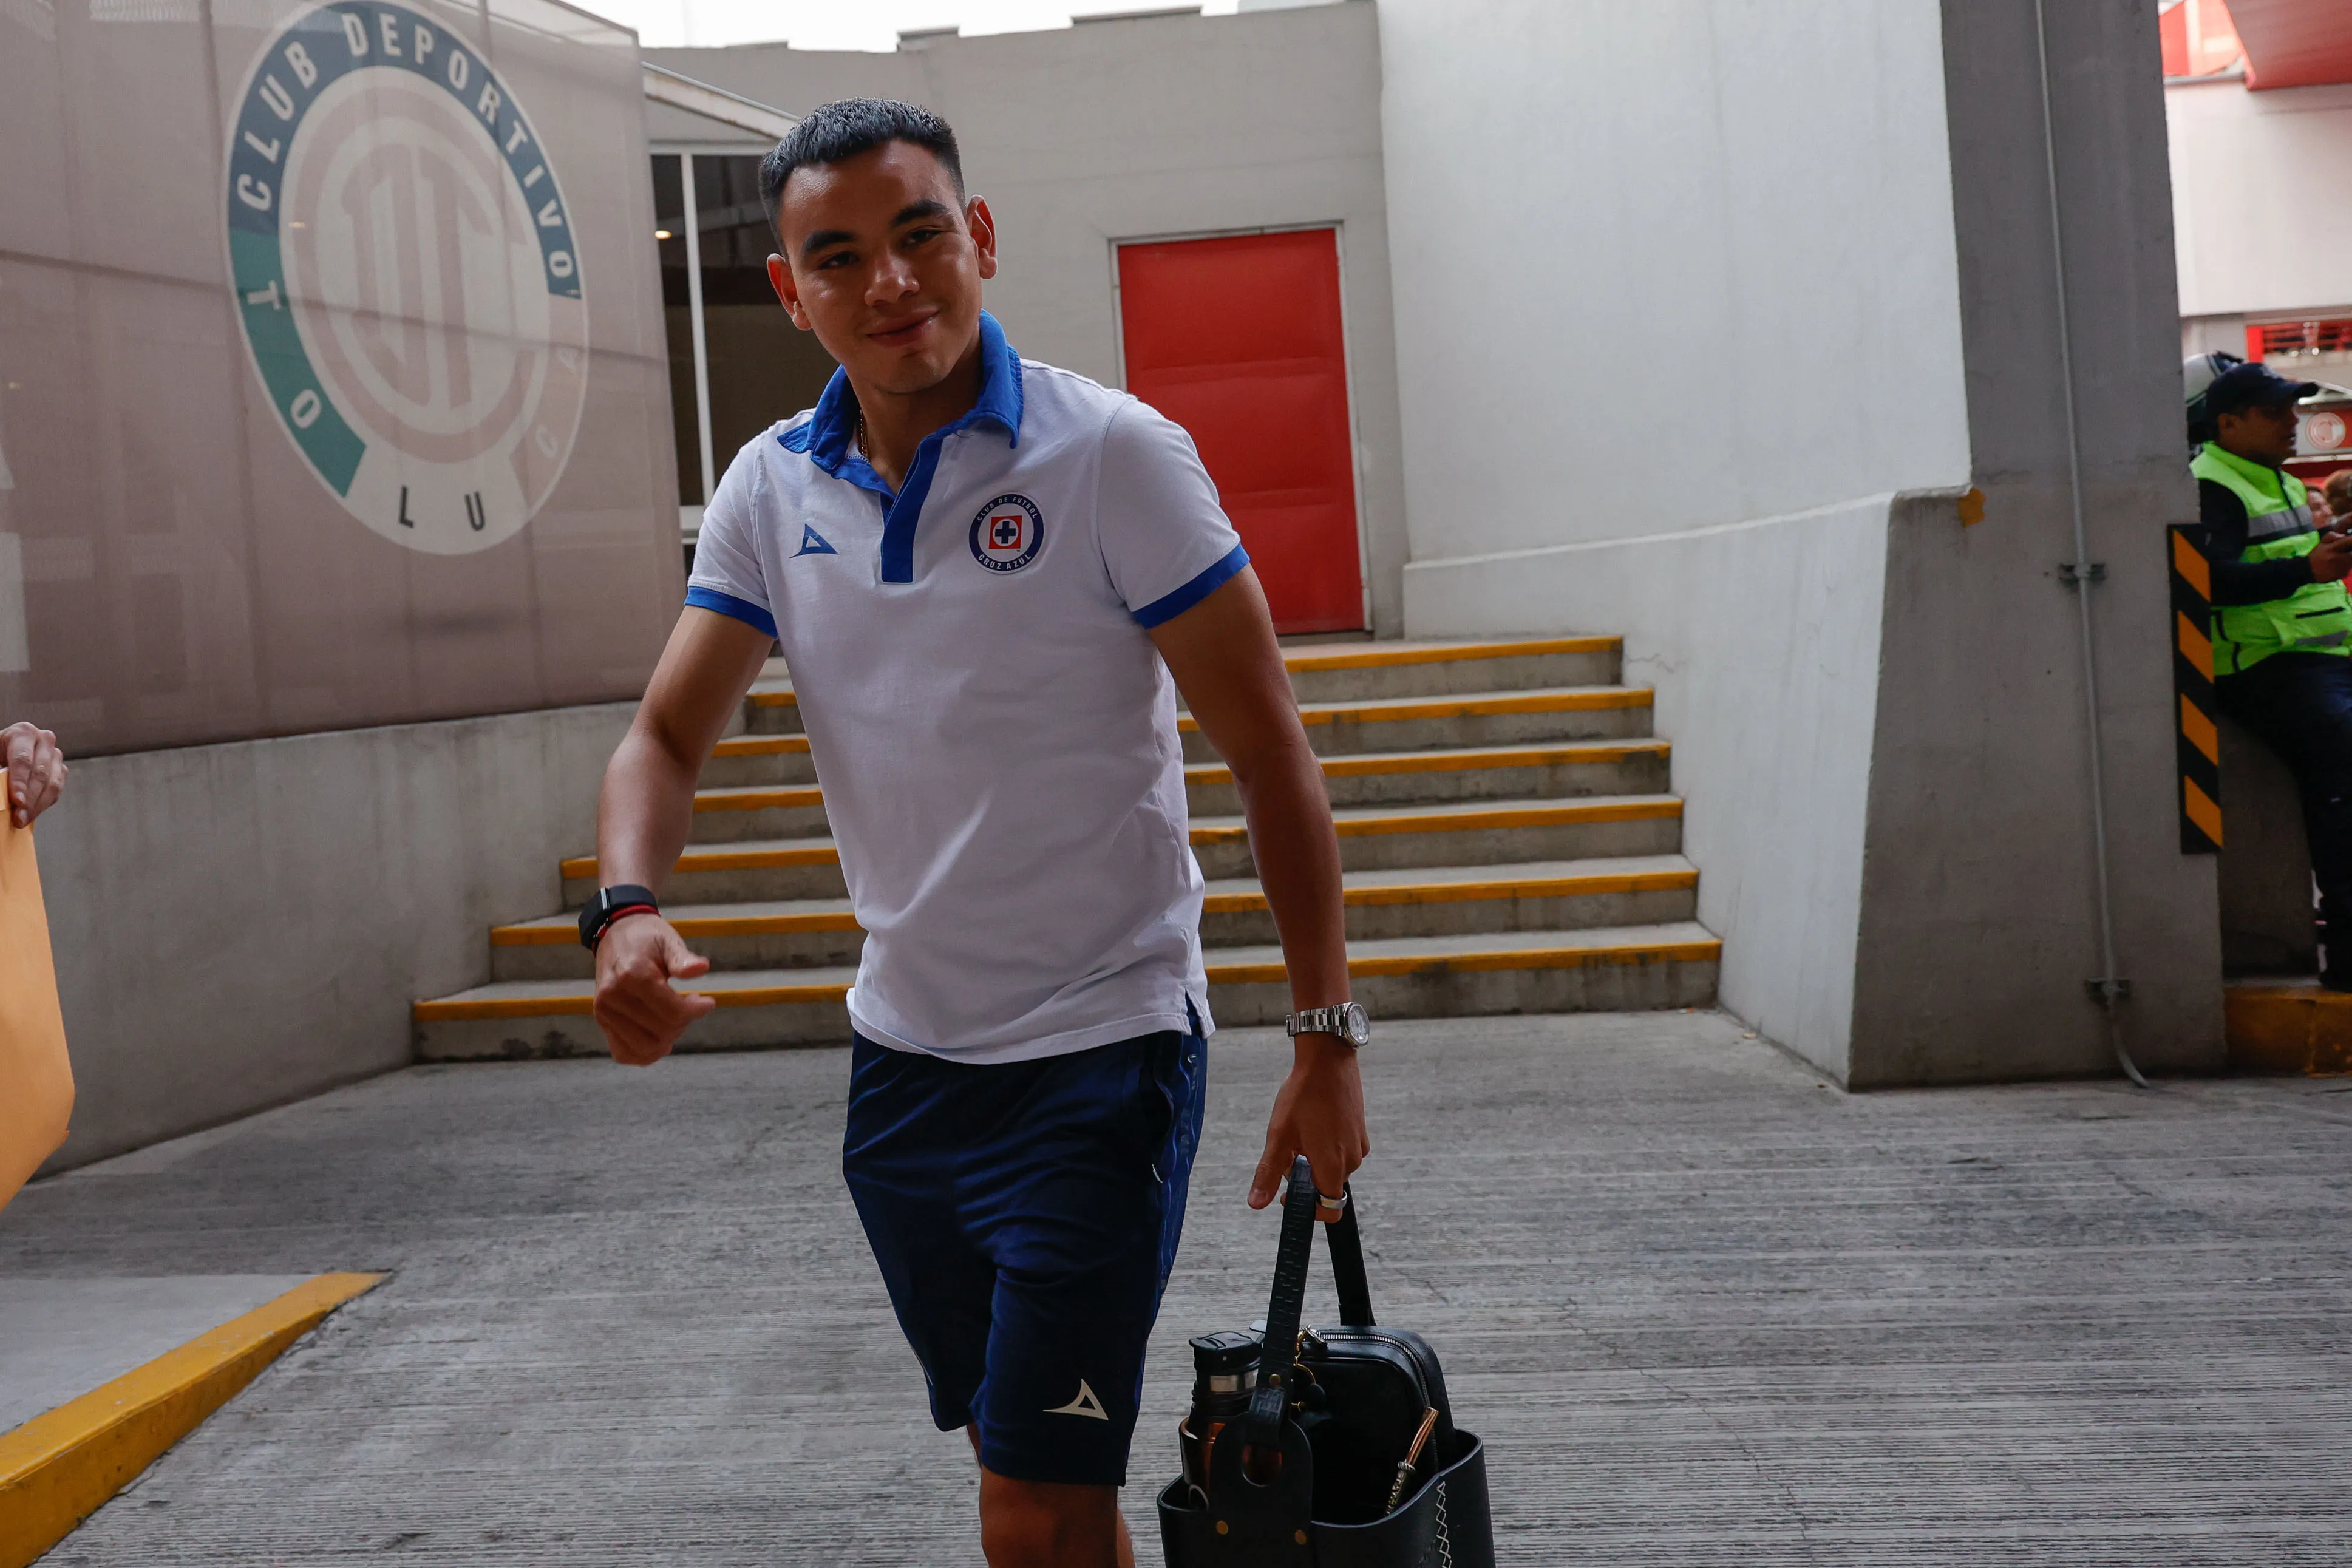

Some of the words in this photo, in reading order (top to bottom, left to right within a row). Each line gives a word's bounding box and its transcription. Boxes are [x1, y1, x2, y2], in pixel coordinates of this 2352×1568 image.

[236, 41, 318, 212] CLUB
[342, 13, 573, 279] DEPORTIVO
[977, 503, 994, 521] CLUB
[1013, 497, 1038, 518] FUTBOL
[979, 554, 1001, 569] CRUZ
[1006, 554, 1032, 569] AZUL
